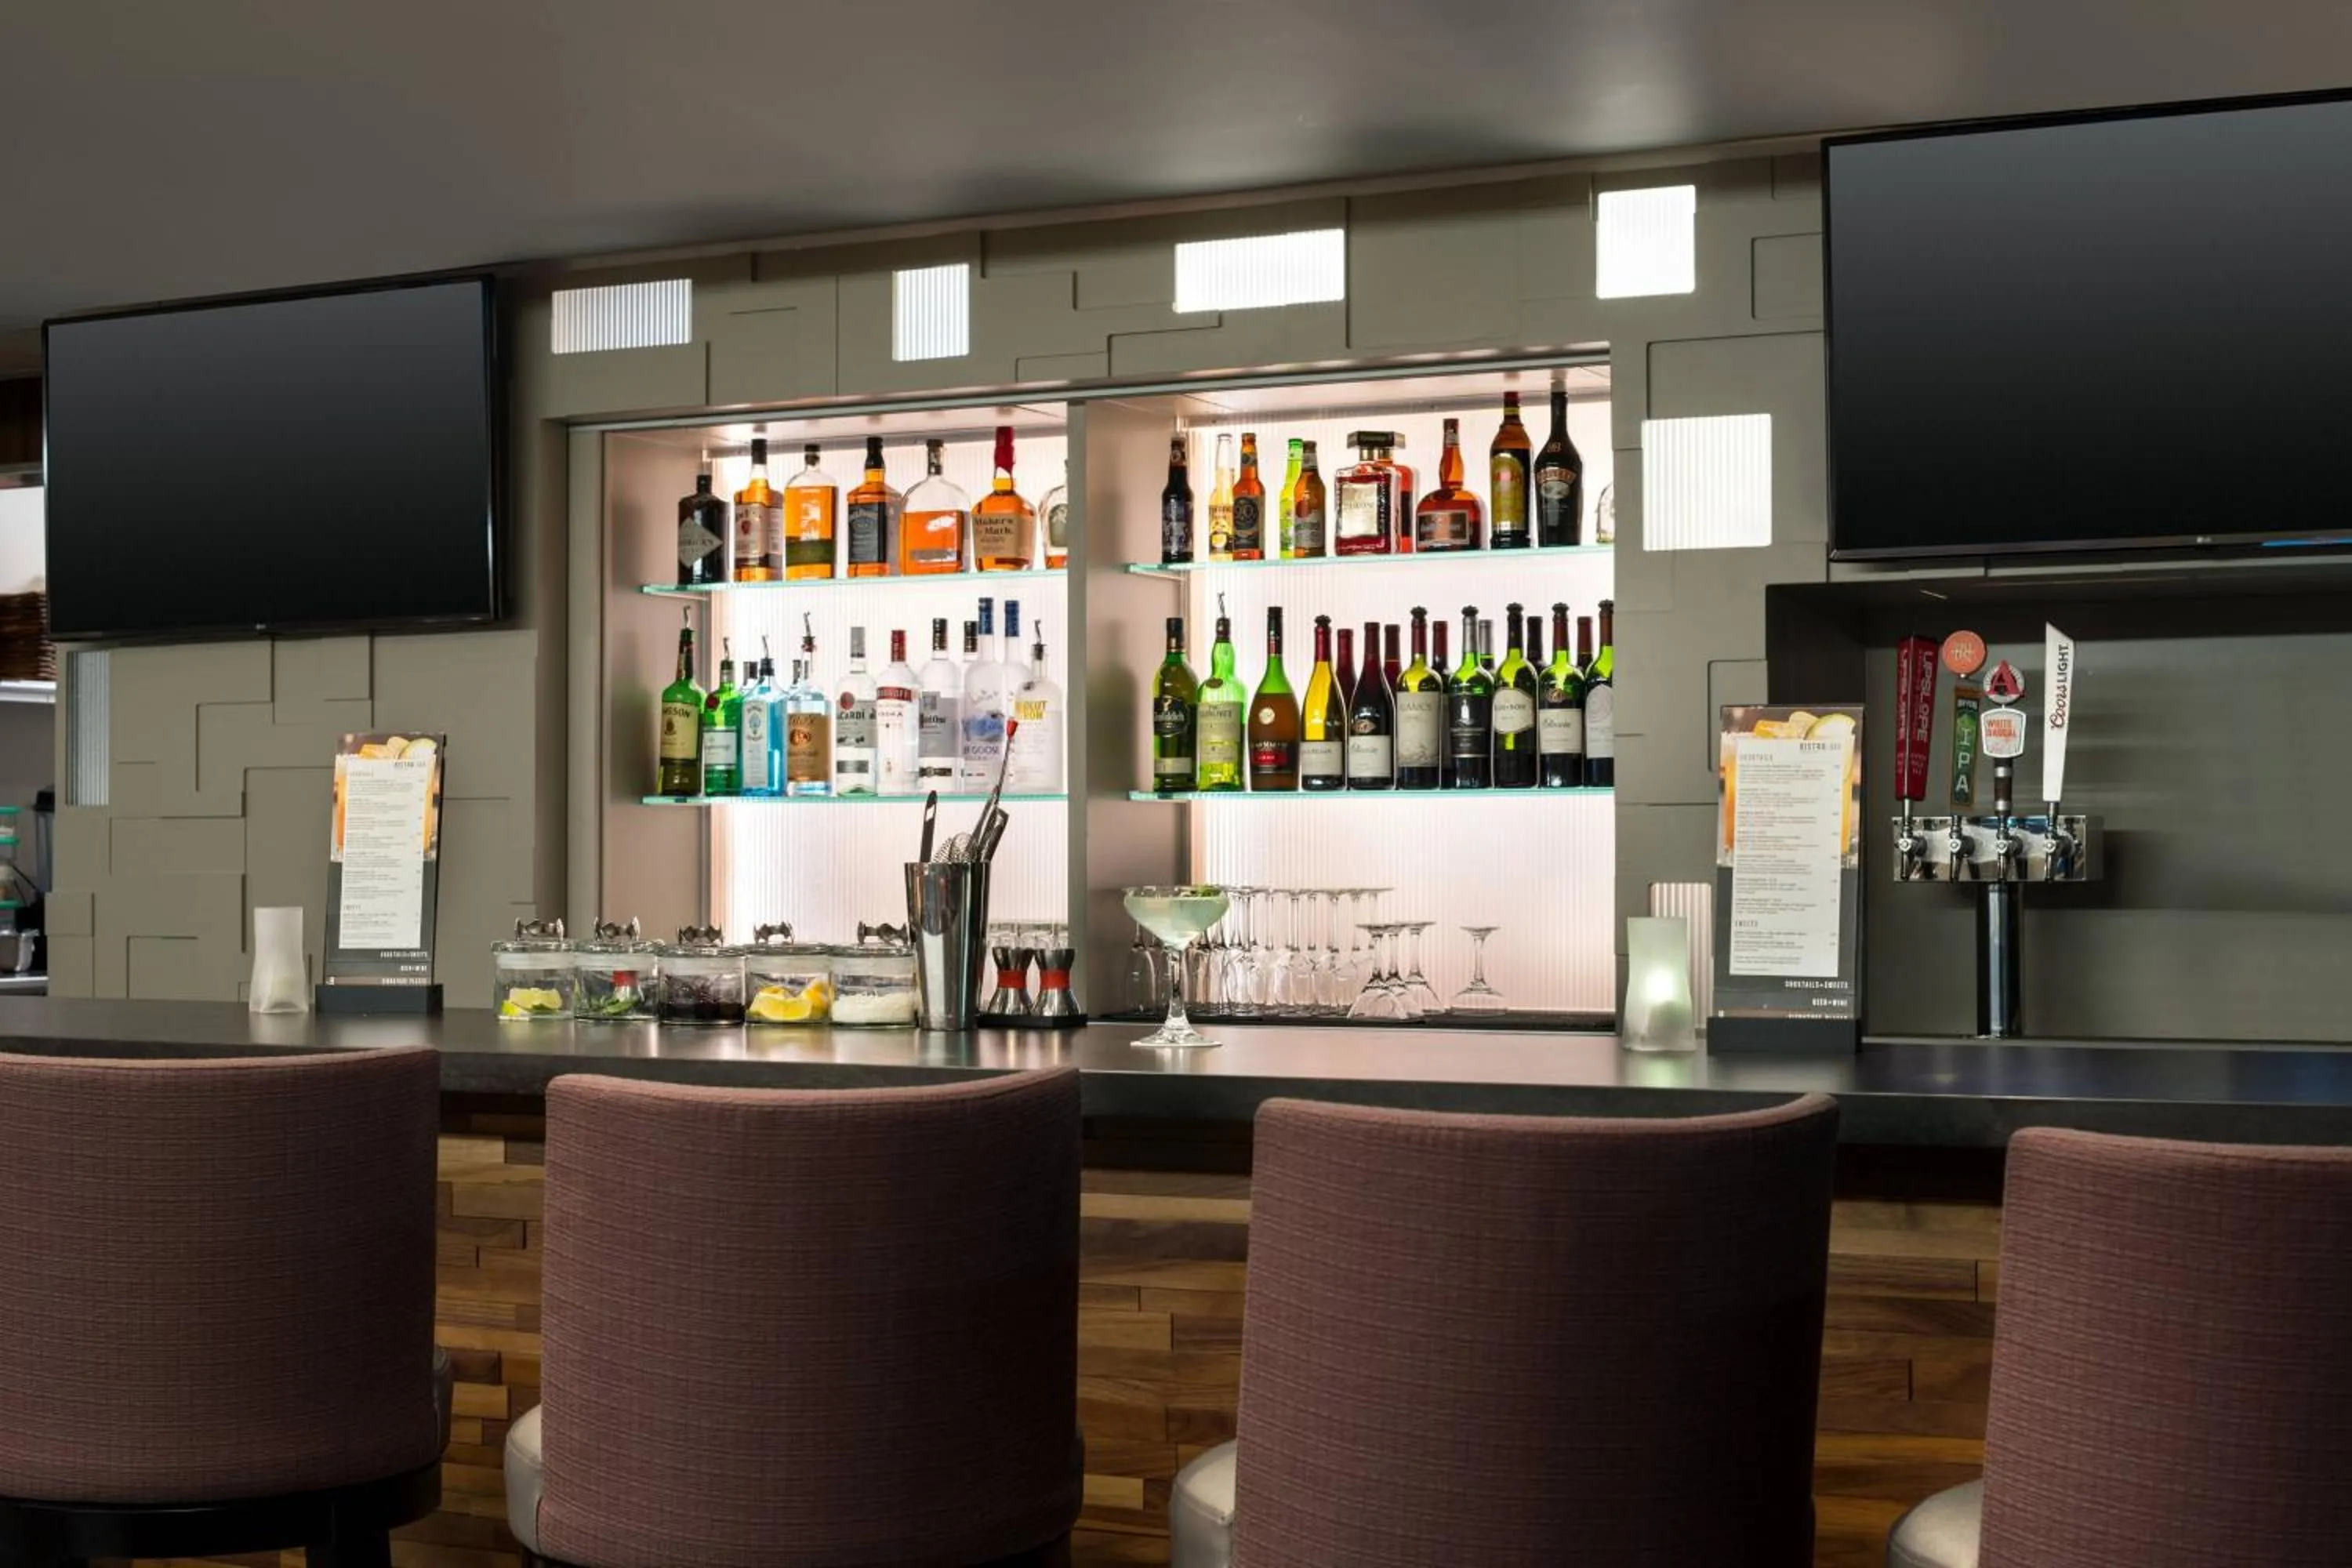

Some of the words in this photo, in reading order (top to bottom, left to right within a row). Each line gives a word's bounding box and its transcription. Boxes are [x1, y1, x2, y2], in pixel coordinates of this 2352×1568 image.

[2056, 643, 2069, 684] LIGHT
[1916, 650, 1934, 742] UPSLOPE
[2050, 685, 2067, 731] Coors
